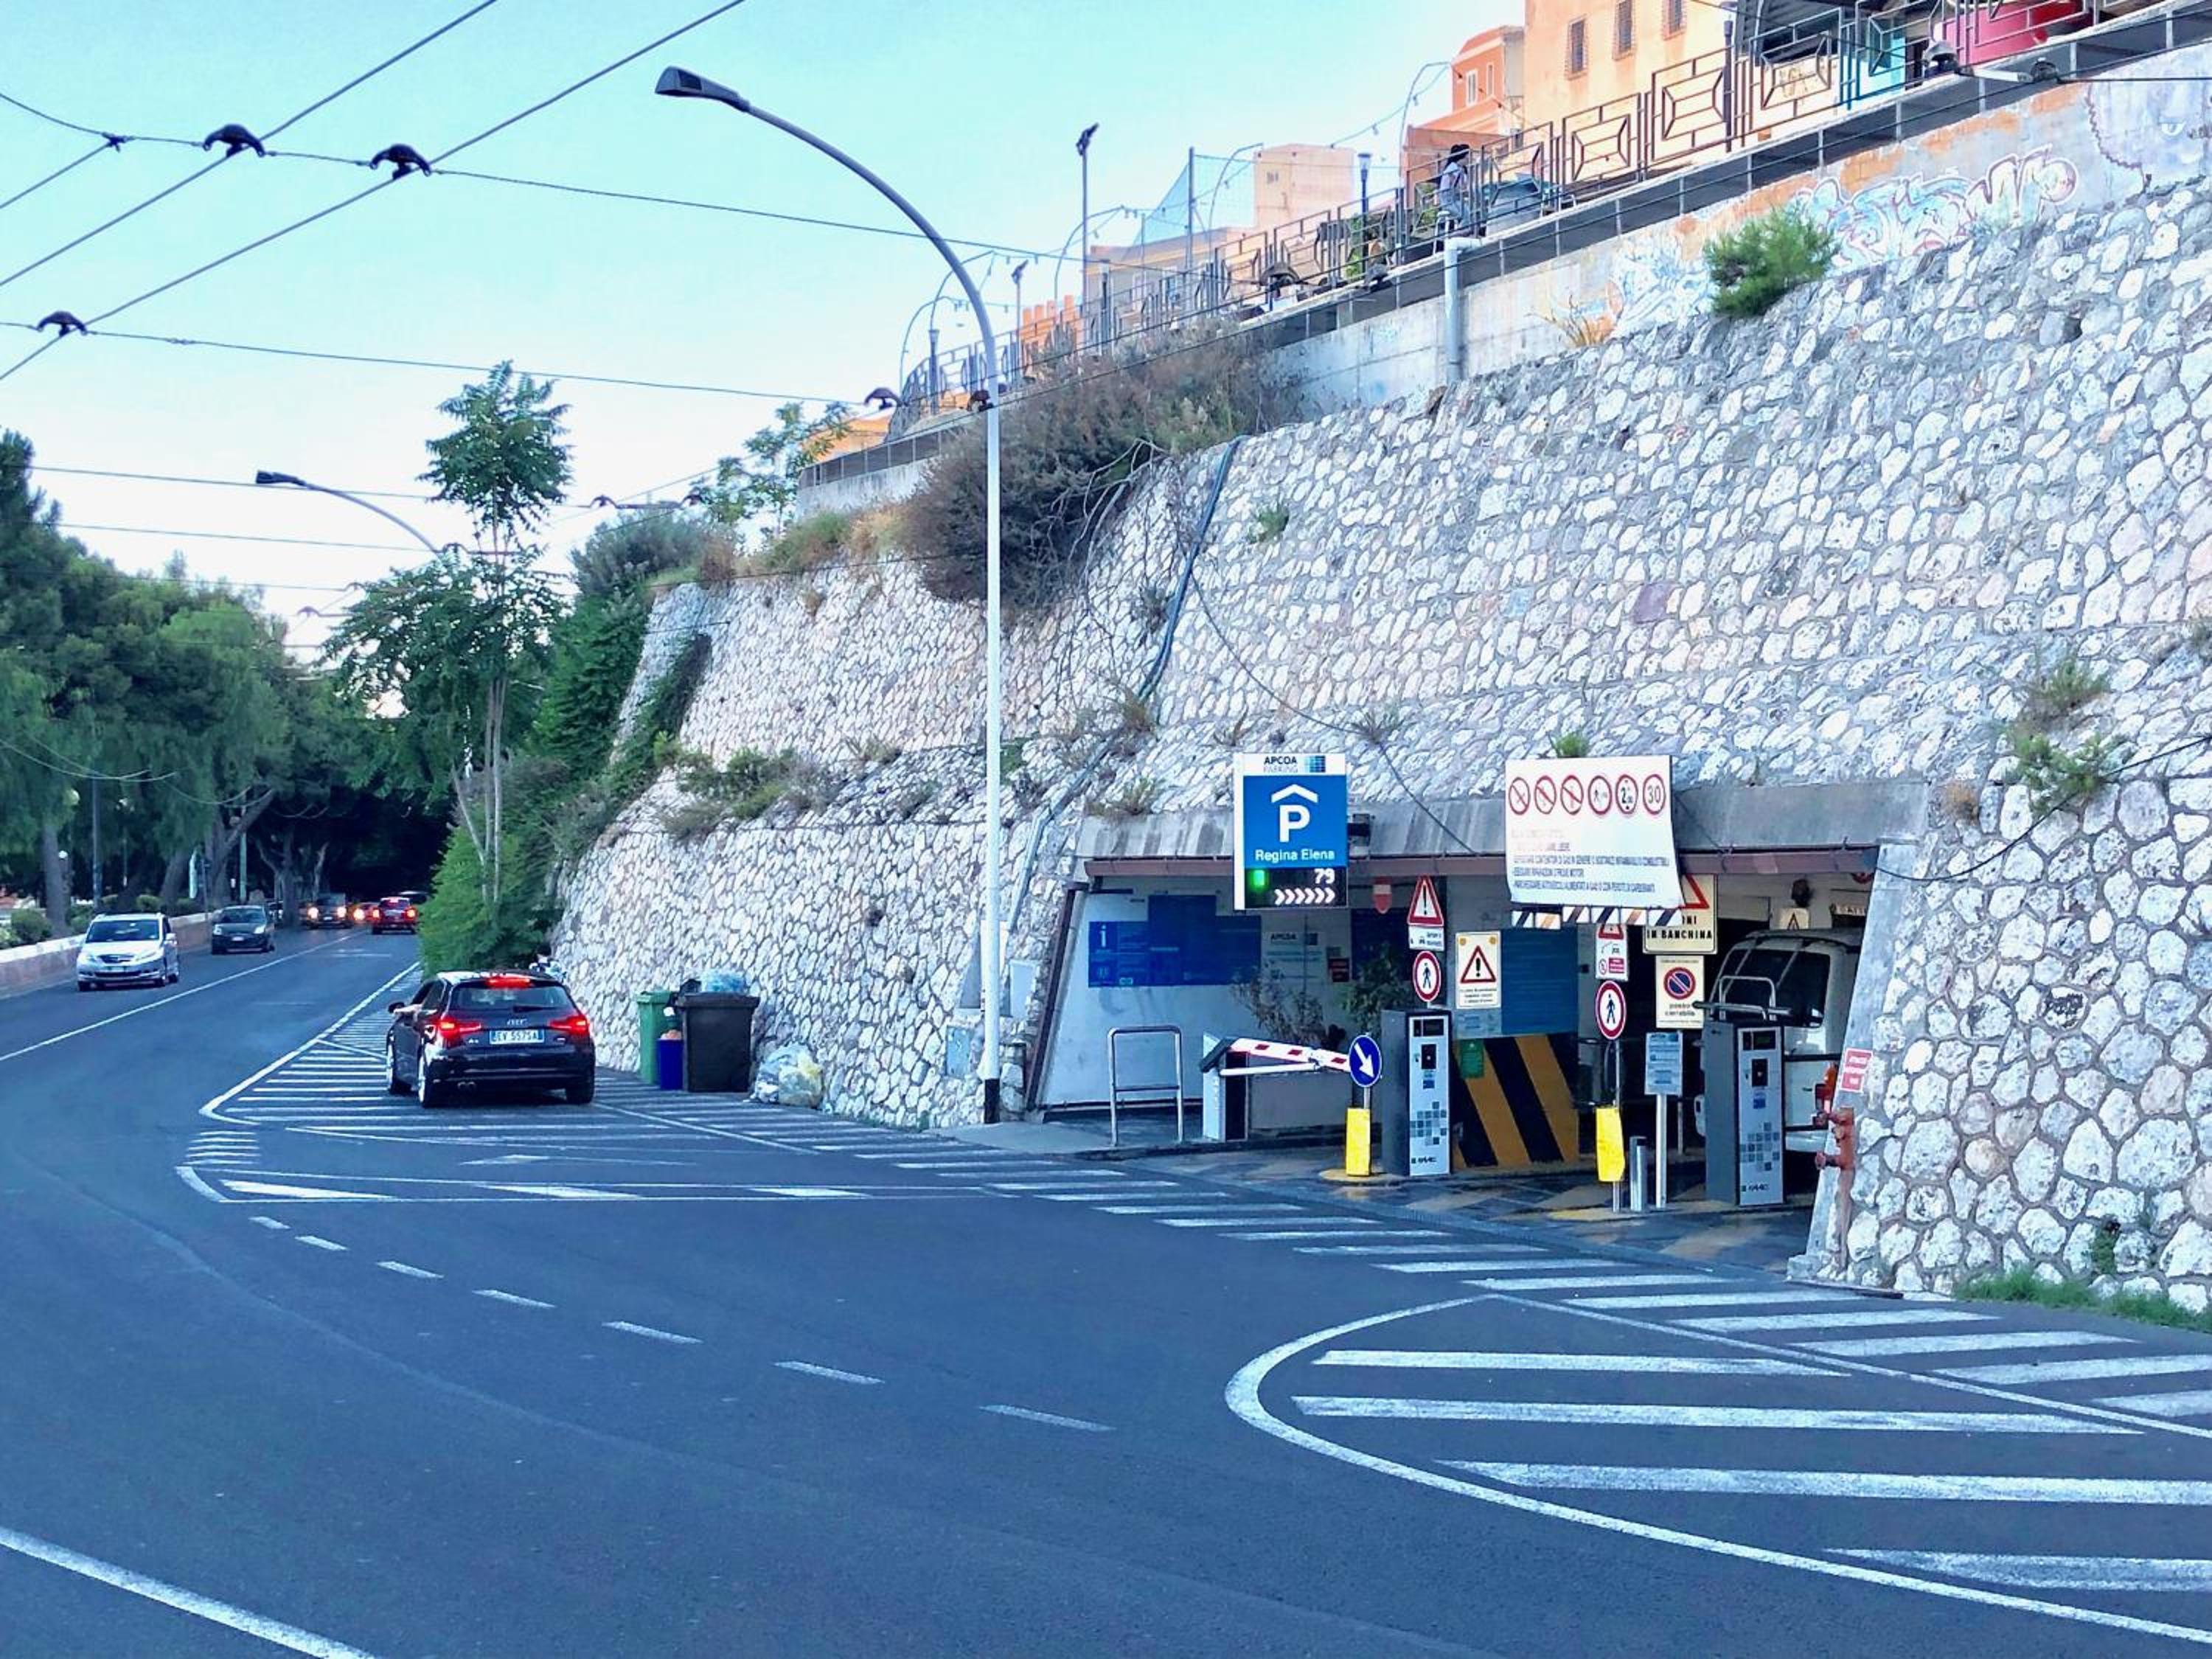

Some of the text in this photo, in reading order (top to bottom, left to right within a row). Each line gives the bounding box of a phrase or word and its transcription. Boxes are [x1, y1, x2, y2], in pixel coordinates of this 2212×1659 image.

[1264, 756, 1298, 765] APCOA
[1647, 785, 1661, 804] 30
[1279, 804, 1310, 842] P
[1255, 849, 1335, 863] Regina Elena
[1314, 868, 1335, 884] 79
[1646, 930, 1712, 939] IN BANCHINA
